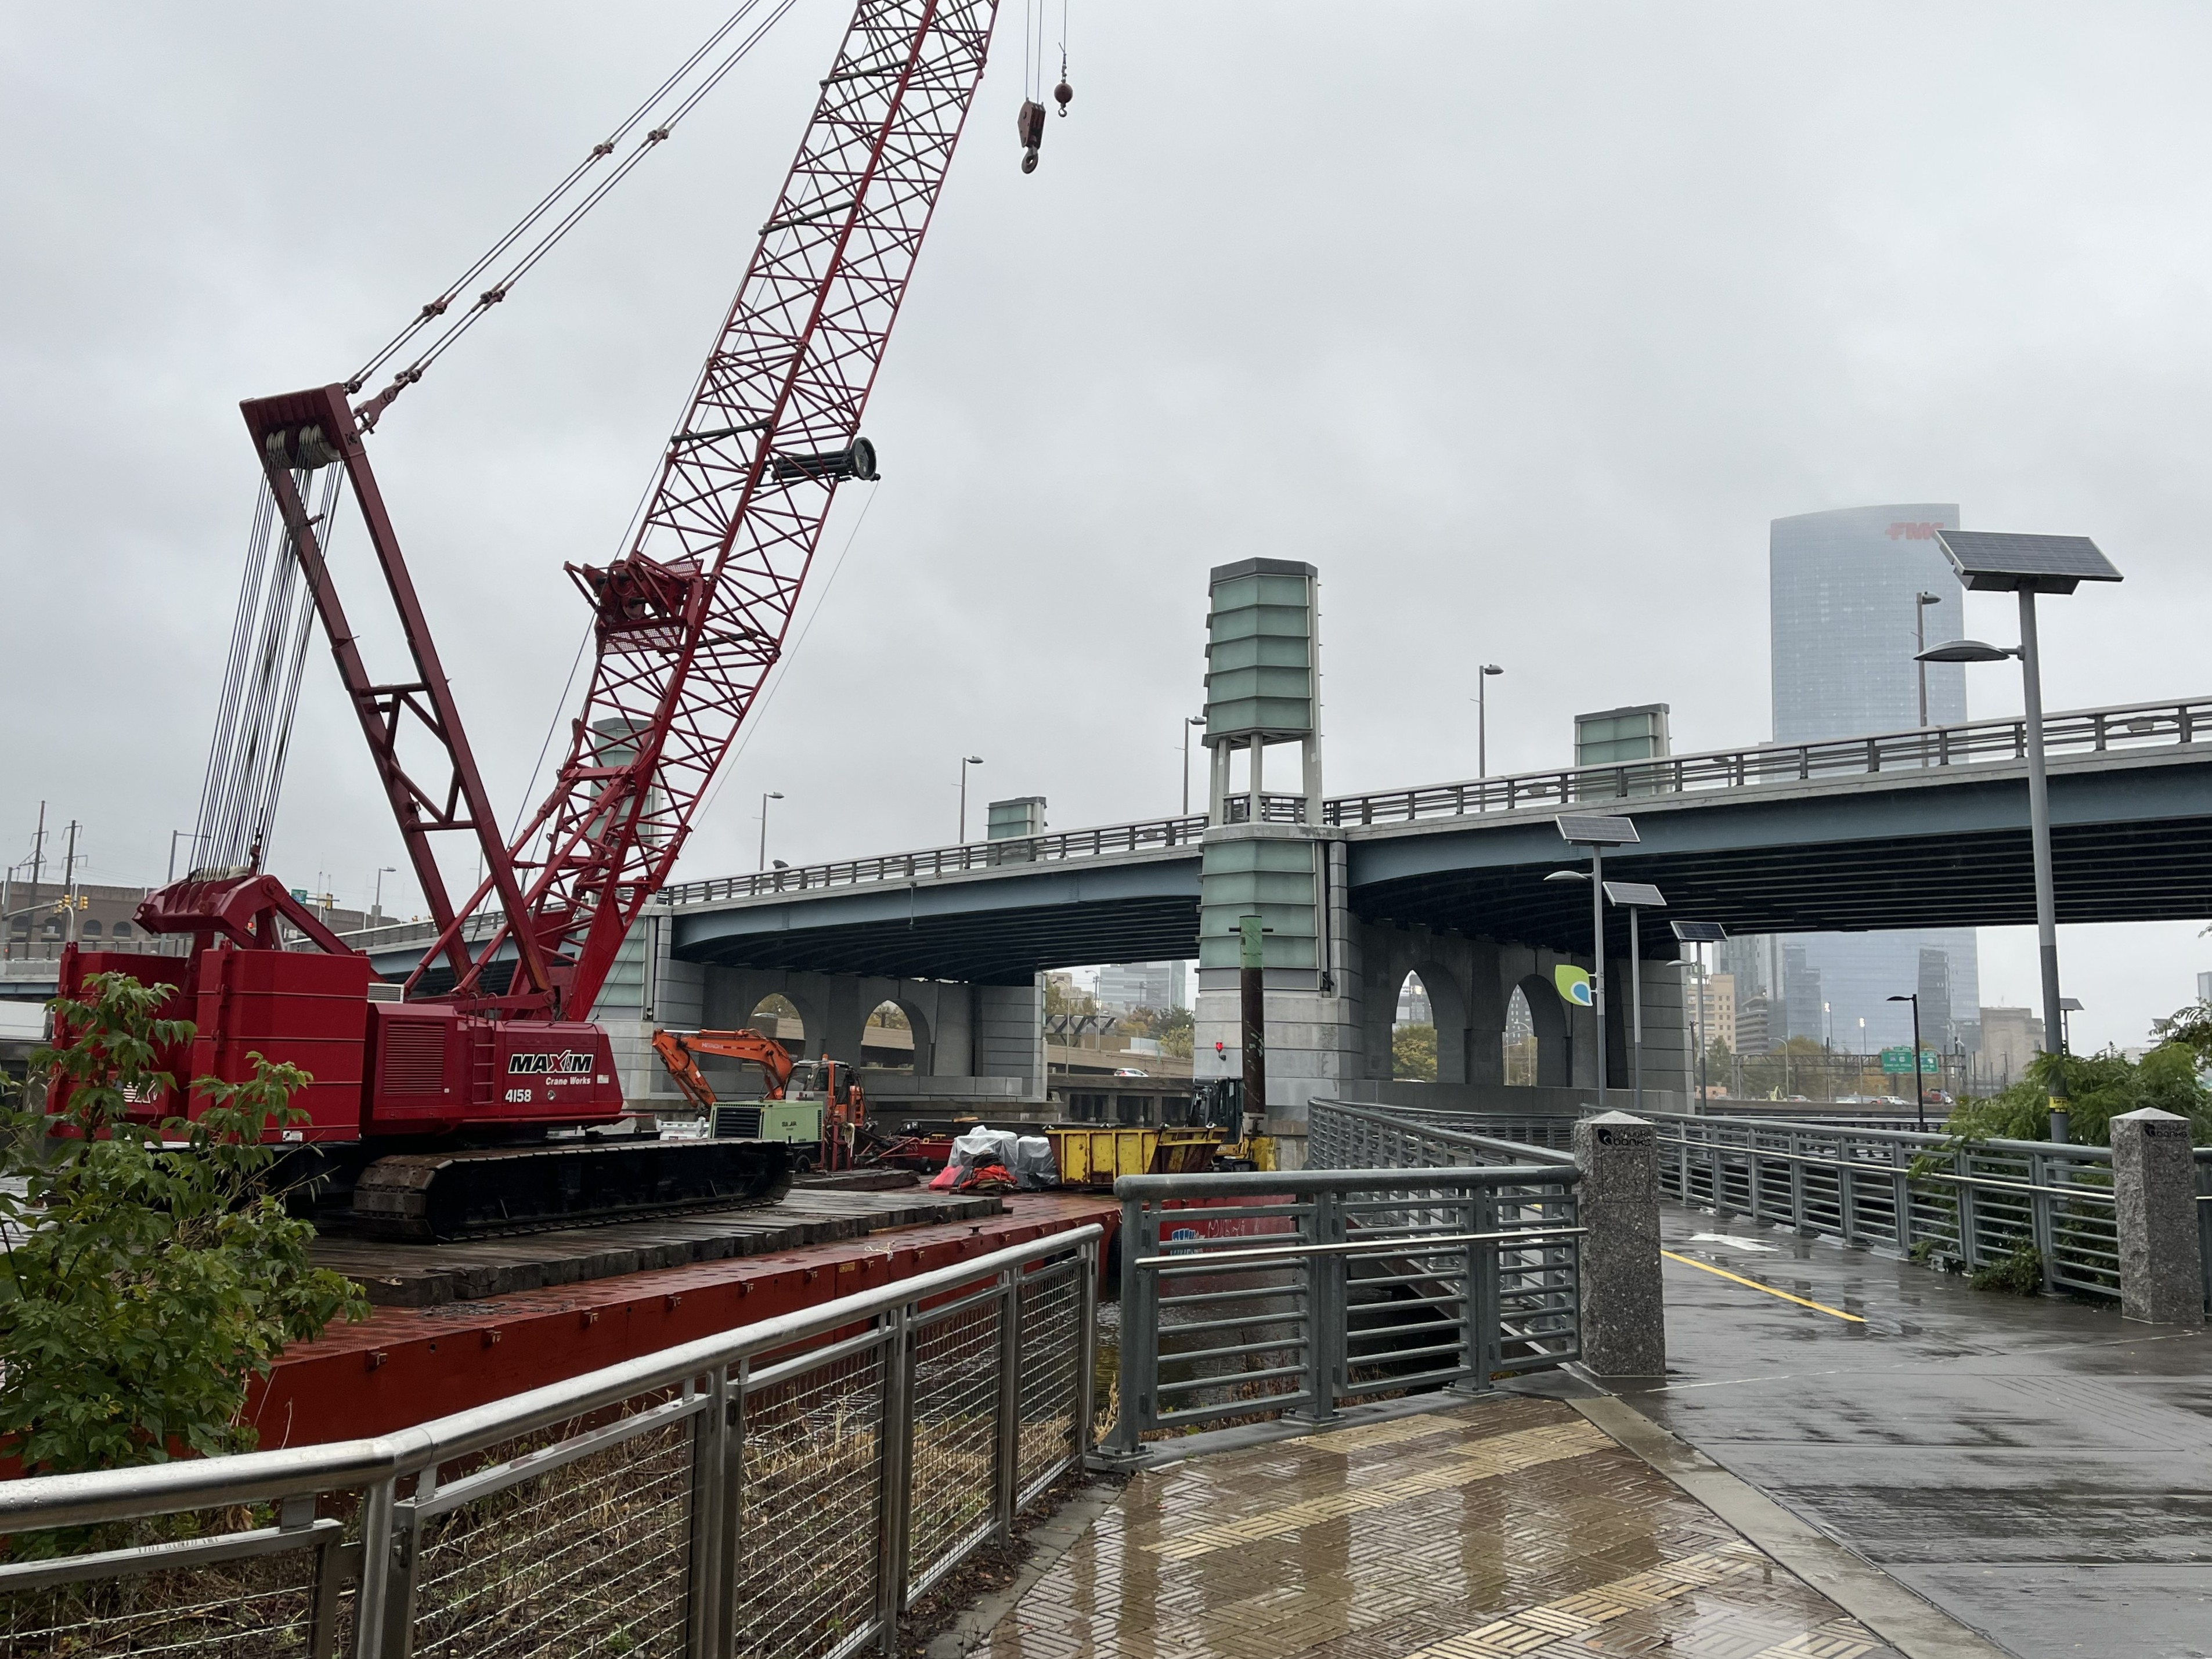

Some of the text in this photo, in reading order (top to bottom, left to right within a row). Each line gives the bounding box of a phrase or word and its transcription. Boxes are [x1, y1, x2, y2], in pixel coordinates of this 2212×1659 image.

[508, 1050, 594, 1074] MAXIM
[546, 1076, 568, 1086] Crane
[570, 1076, 591, 1085] Works
[505, 1089, 532, 1103] 4158
